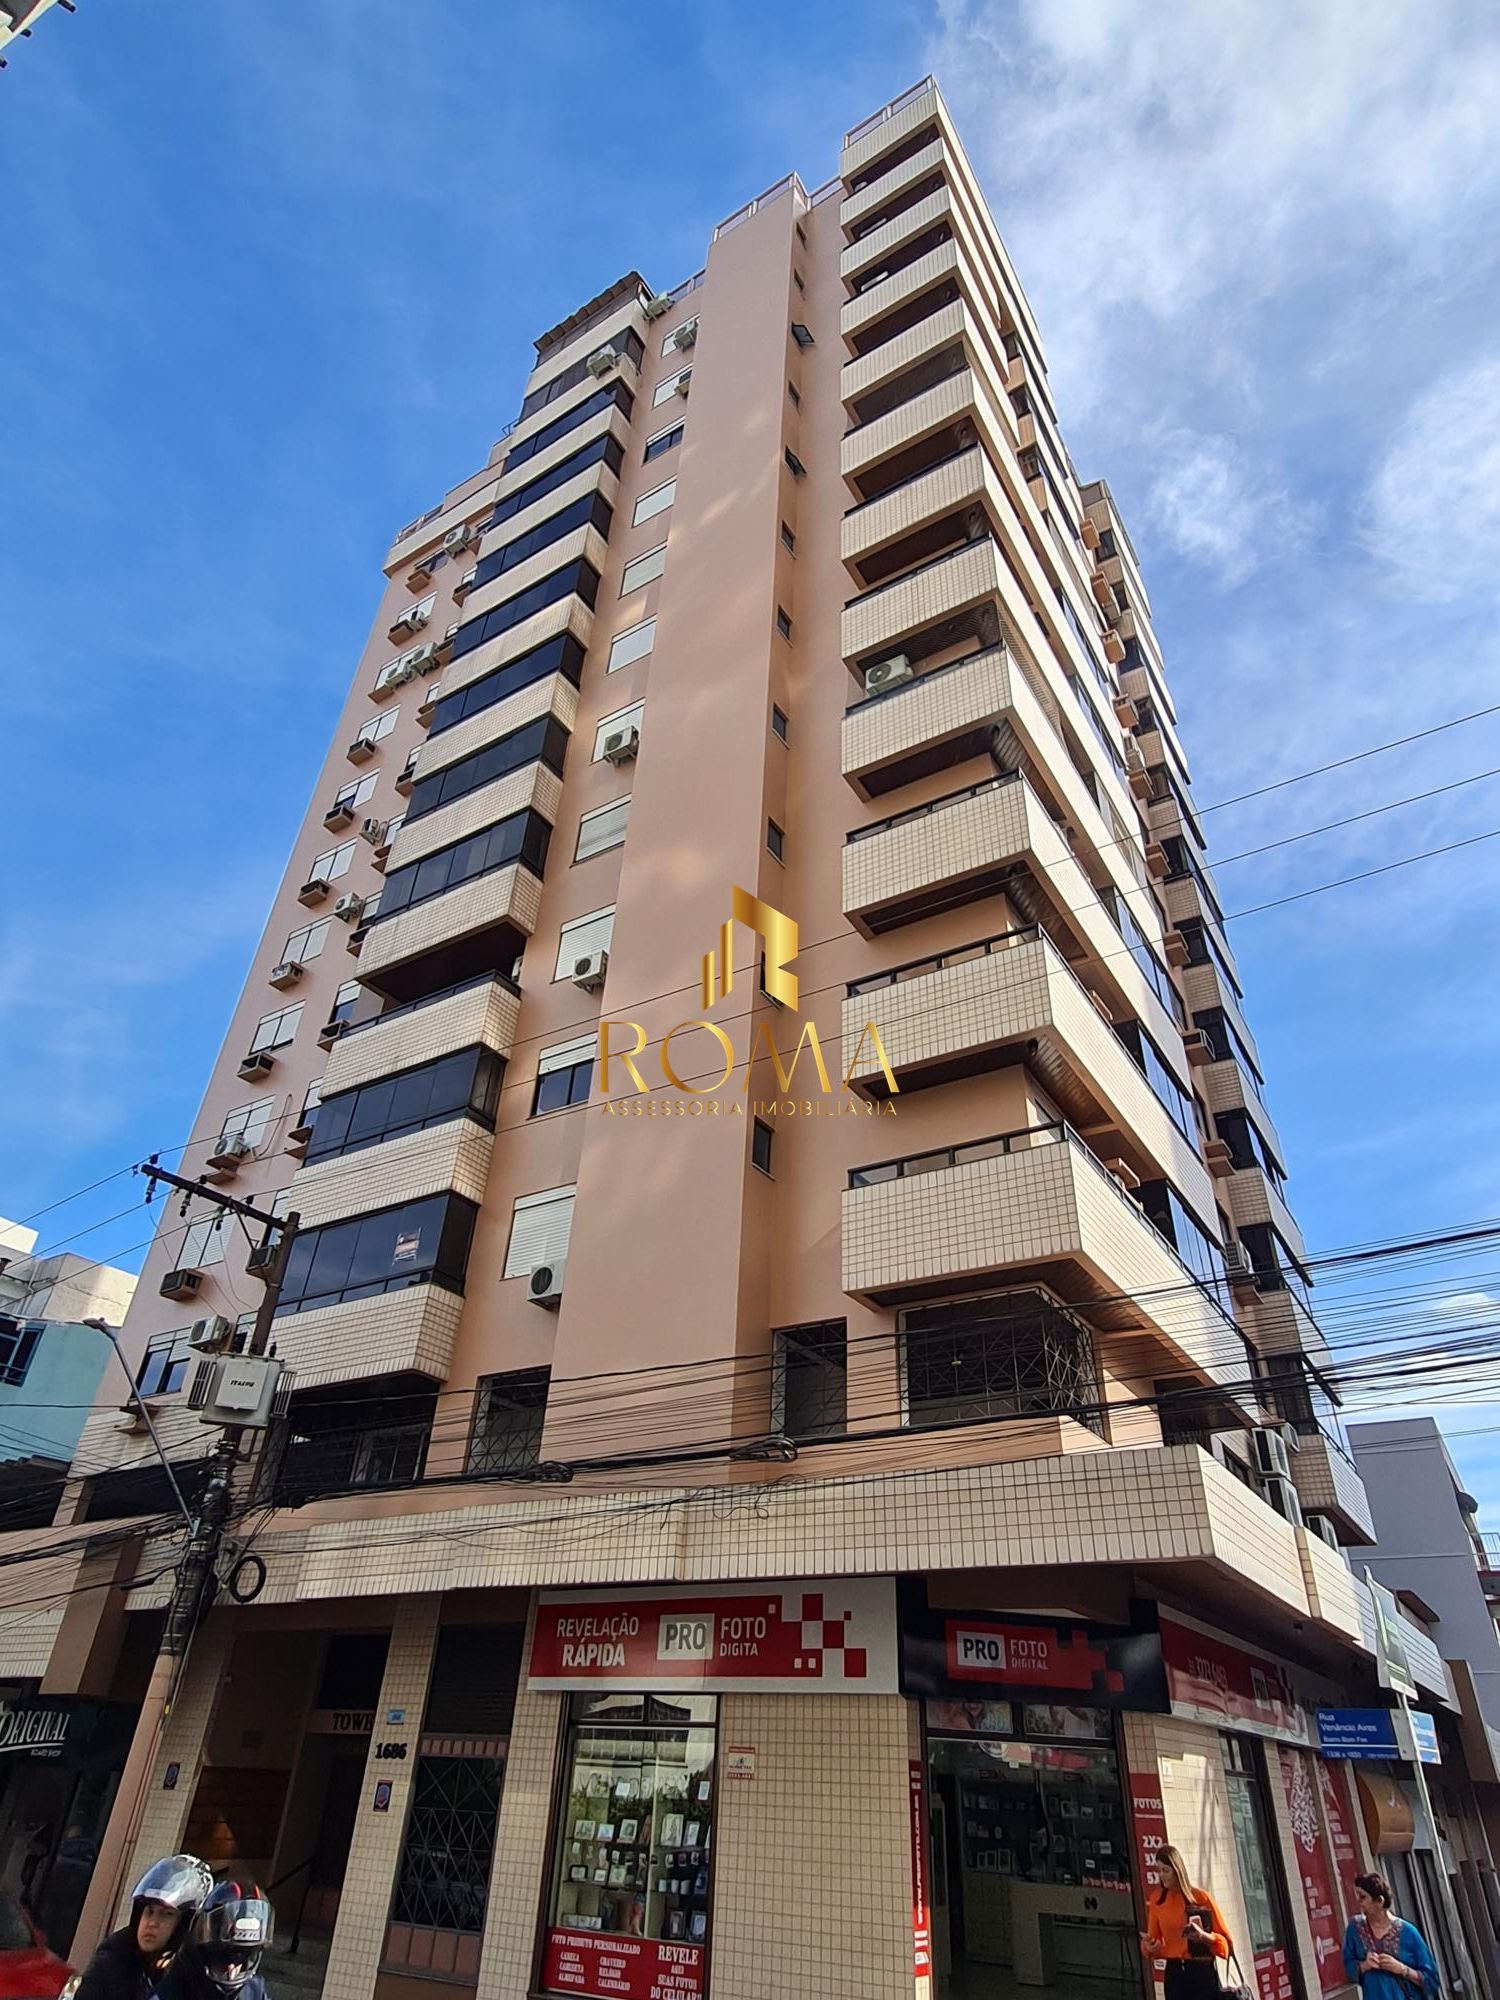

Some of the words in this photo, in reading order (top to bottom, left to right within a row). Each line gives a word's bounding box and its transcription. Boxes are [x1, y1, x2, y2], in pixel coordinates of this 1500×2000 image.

[556, 1613, 639, 1641] REVELAÇÃO
[720, 1616, 767, 1639] FOTO
[664, 1623, 707, 1650] PRO
[562, 1637, 626, 1667] RÁPIDA
[719, 1642, 759, 1657] DIGITA
[962, 1638, 1000, 1661] PRO
[1010, 1639, 1047, 1658] FOTO
[1011, 1657, 1048, 1670] DIGITAL
[1318, 1712, 1335, 1721] Rua
[1133, 1797, 1163, 1810] FOTOS
[1144, 1853, 1159, 1867] 3X
[1146, 1872, 1161, 1885] 5X
[552, 1934, 567, 1945] FOTO
[658, 1945, 699, 1966] REVELE
[657, 1974, 675, 1987] SUAS
[650, 1985, 661, 2000] DO
